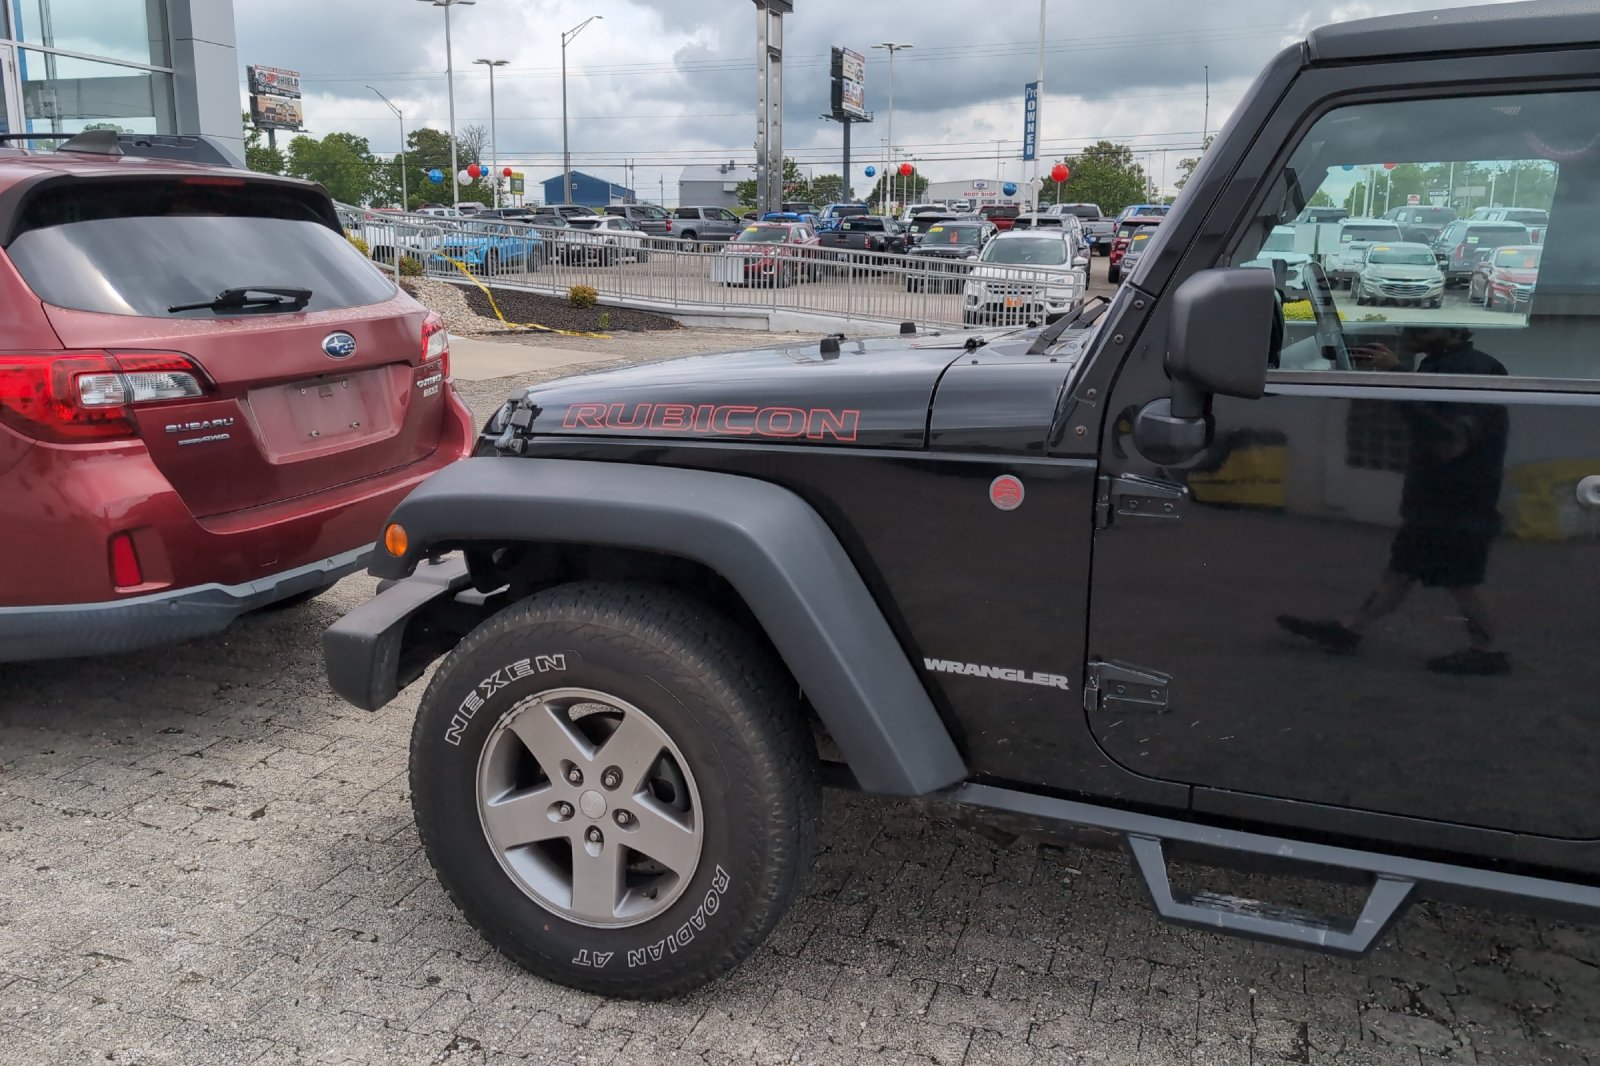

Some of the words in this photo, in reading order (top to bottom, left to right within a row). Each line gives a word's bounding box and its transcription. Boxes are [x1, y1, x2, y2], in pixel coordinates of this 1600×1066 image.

[1026, 88, 1037, 99] Pre
[1027, 100, 1036, 155] OWNED
[165, 417, 234, 432] SUBARU
[563, 403, 860, 441] RUBICON
[923, 657, 1070, 690] WRANGLER
[445, 654, 566, 746] NEXEN
[627, 864, 731, 968] ROADIAN
[572, 949, 614, 968] AT
